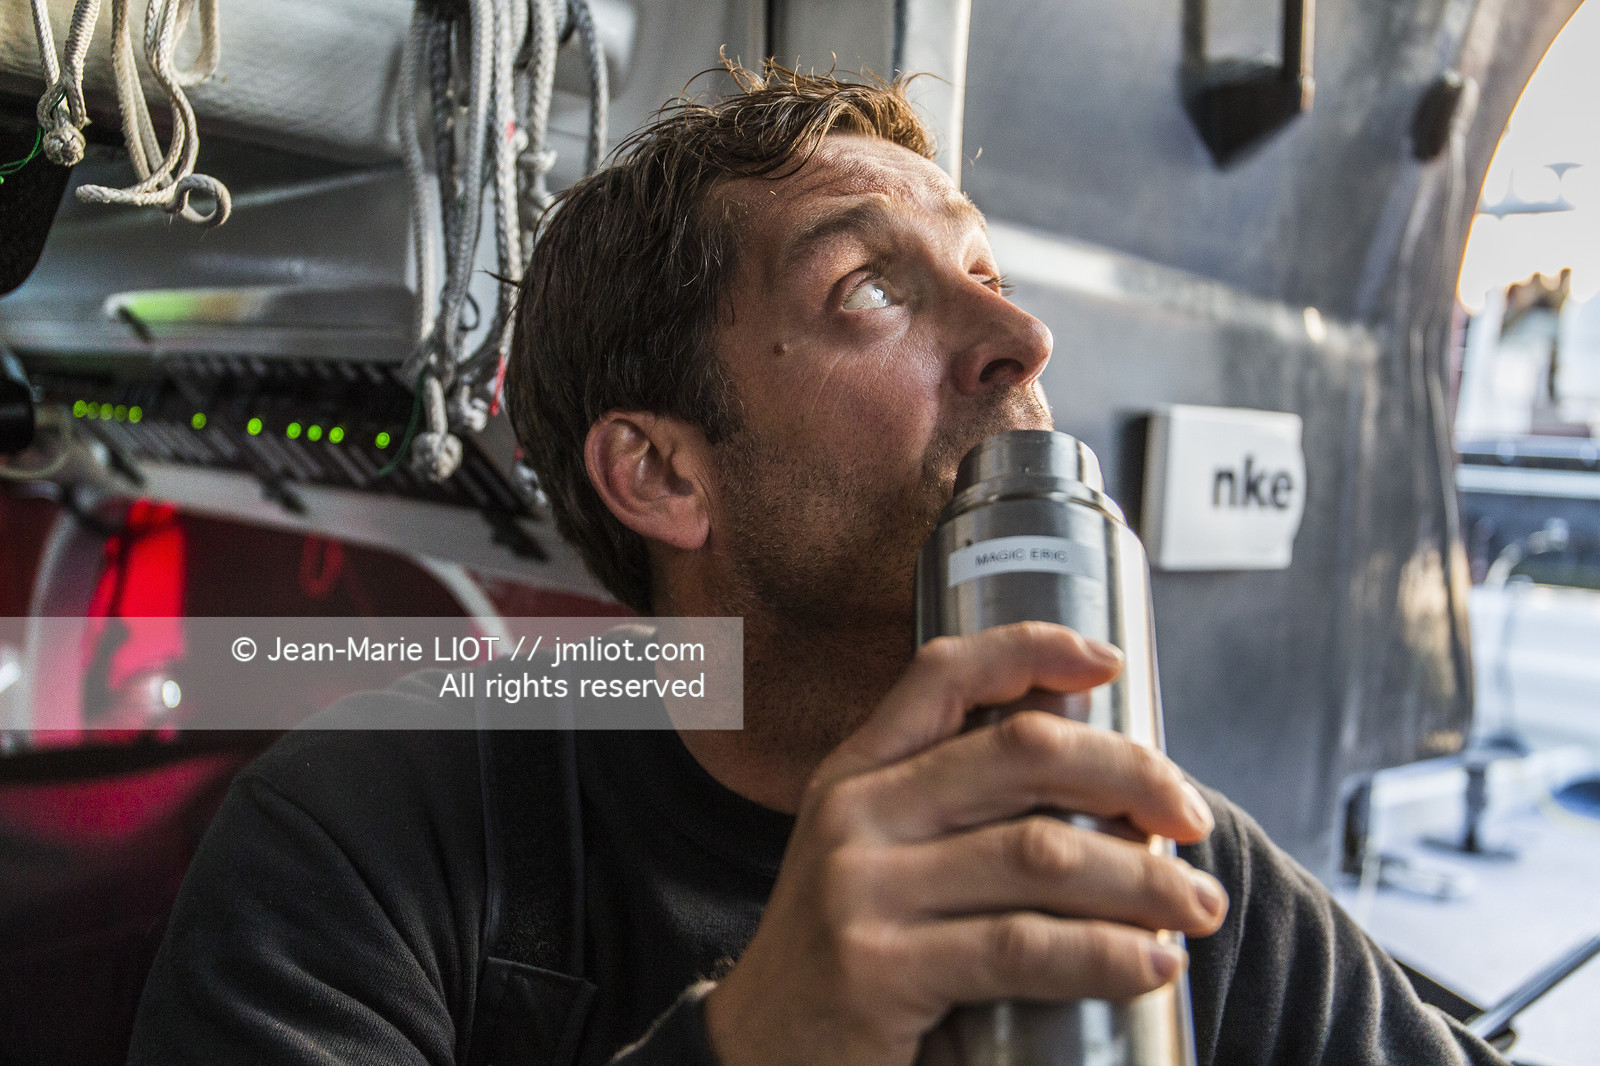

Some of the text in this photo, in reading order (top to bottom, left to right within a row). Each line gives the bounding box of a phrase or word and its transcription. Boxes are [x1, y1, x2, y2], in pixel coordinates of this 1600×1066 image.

[1212, 455, 1293, 509] nke
[975, 547, 1068, 566] MAGIC ERIC
